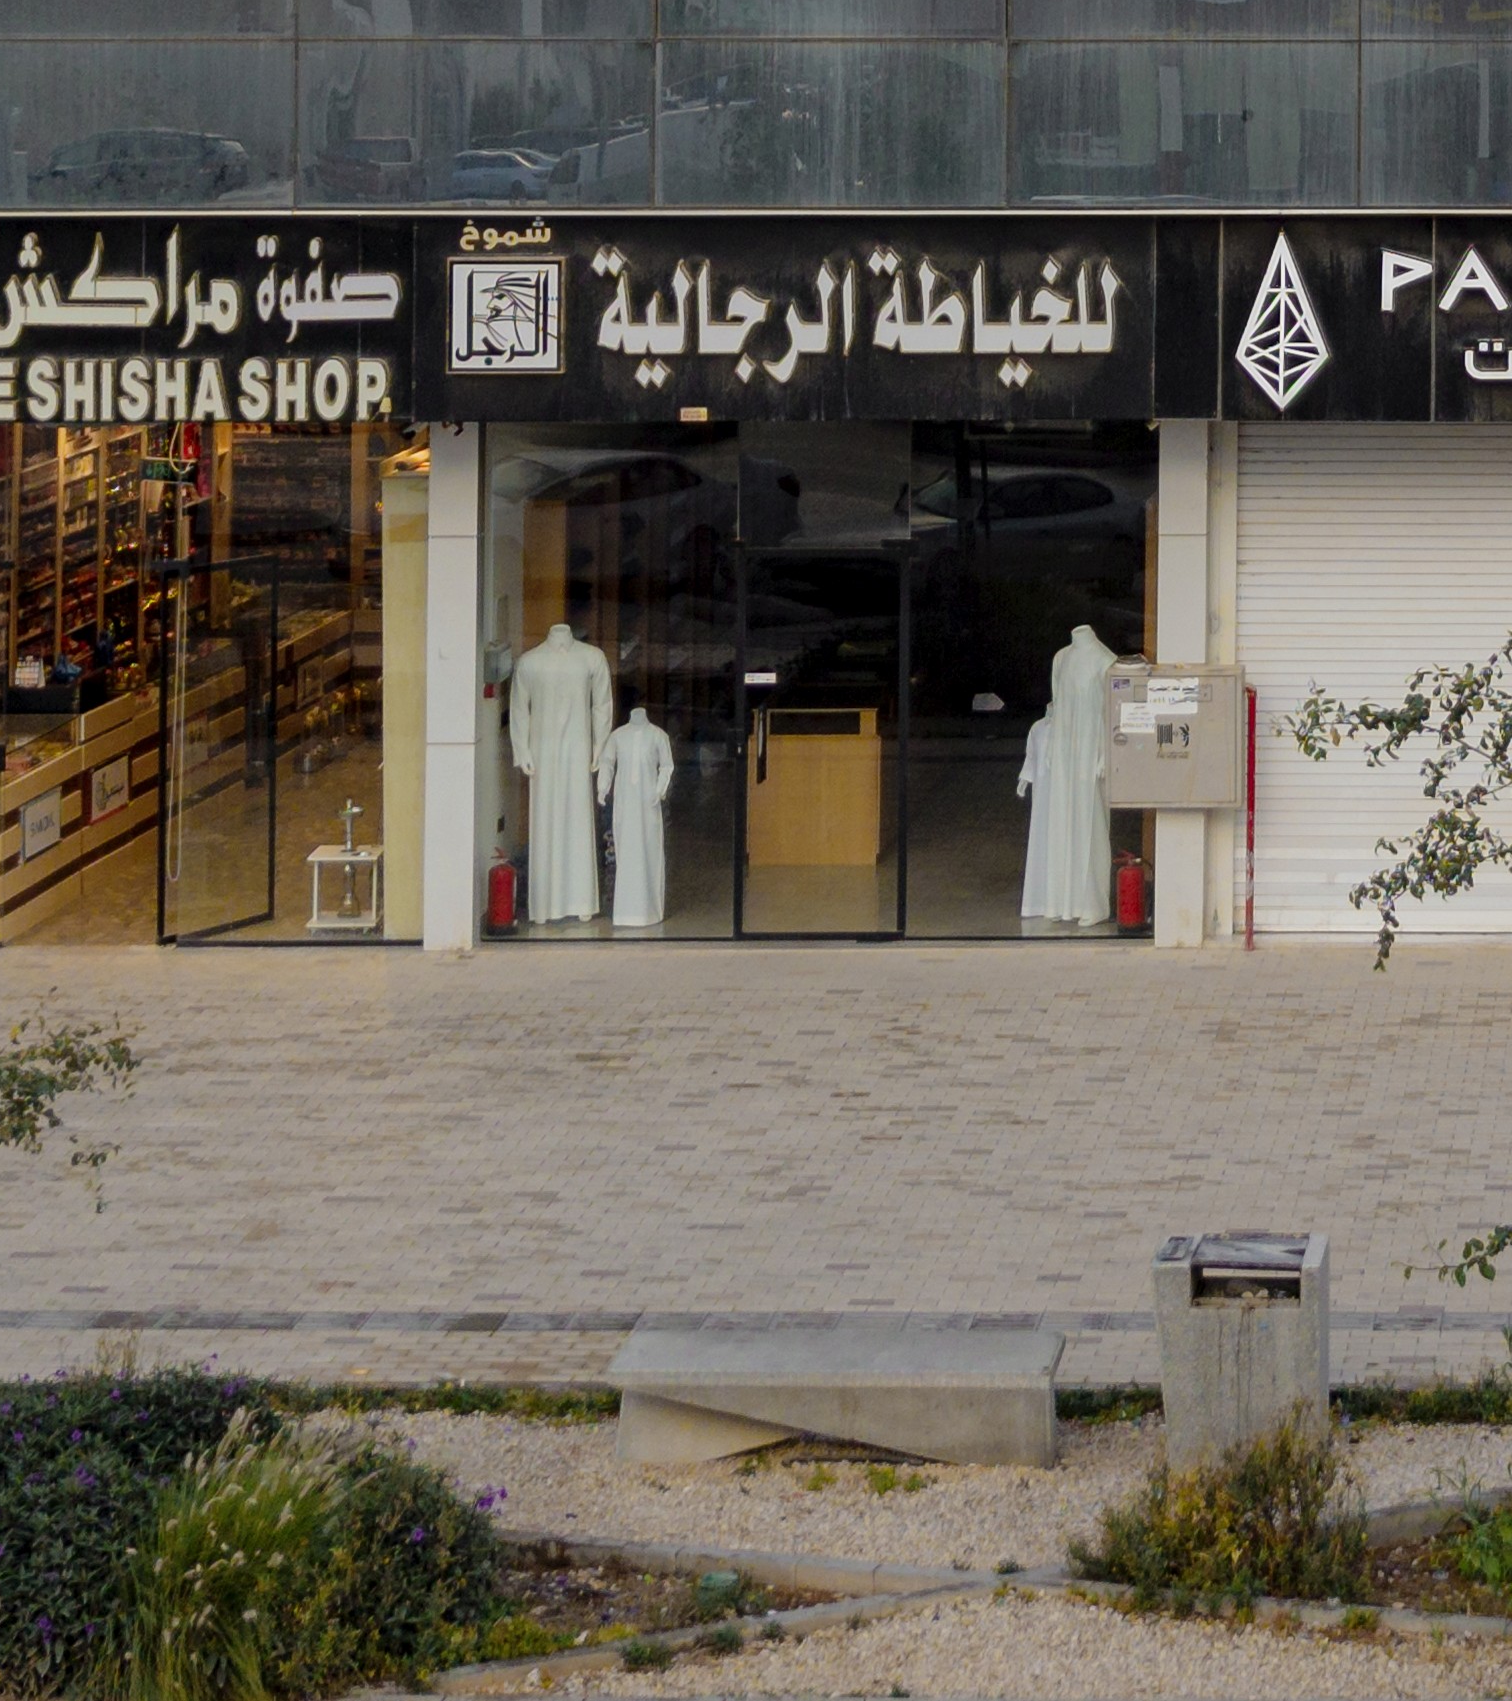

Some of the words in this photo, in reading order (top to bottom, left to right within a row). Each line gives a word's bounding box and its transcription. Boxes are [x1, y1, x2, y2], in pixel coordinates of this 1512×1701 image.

[459, 215, 552, 251] شموخ
[256, 234, 402, 344] صفوة
[590, 244, 858, 388] الرجالية
[868, 246, 1124, 388] للخياطة
[26, 357, 228, 422] SHISHA
[238, 357, 391, 422] SHOP
